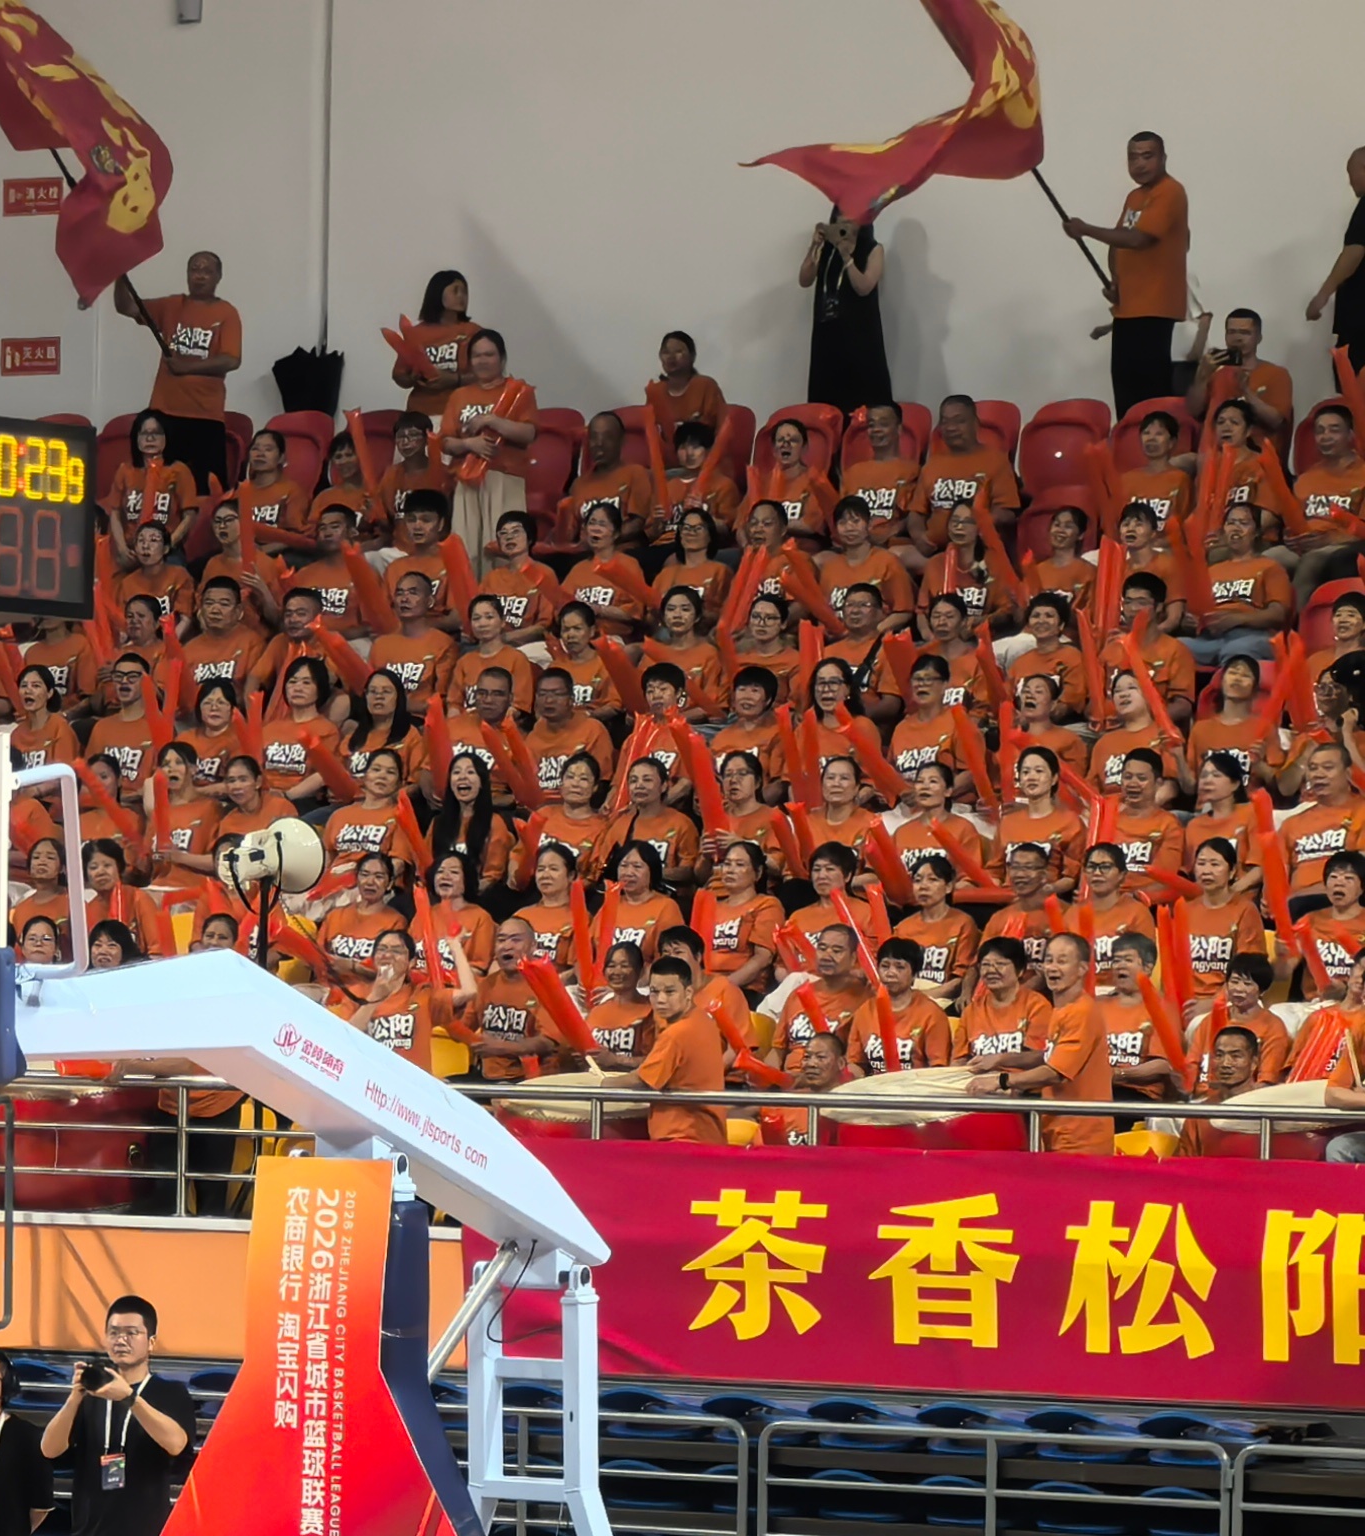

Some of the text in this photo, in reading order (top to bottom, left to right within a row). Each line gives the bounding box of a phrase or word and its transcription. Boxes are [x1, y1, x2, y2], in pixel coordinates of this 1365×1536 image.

[933, 477, 977, 499] 松阳
[1212, 578, 1255, 599] 松阳
[194, 660, 235, 682] 松阳
[265, 743, 307, 764] 松阳
[897, 745, 940, 771] 松阳
[334, 823, 388, 845] 松阳
[1294, 828, 1346, 854] 松阳
[369, 1012, 415, 1038] 松阳
[482, 1003, 528, 1031] 松阳
[590, 1028, 636, 1050] 松阳
[972, 1032, 1024, 1056] 松阳
[682, 1189, 1365, 1365] 茶香松阳
[273, 1186, 311, 1430] 农商银行 淘宝闪购
[333, 1324, 347, 1363] CITY
[299, 1188, 340, 1536] 2026浙江省城市篮球联赛
[328, 1367, 346, 1471] BASKETBALL
